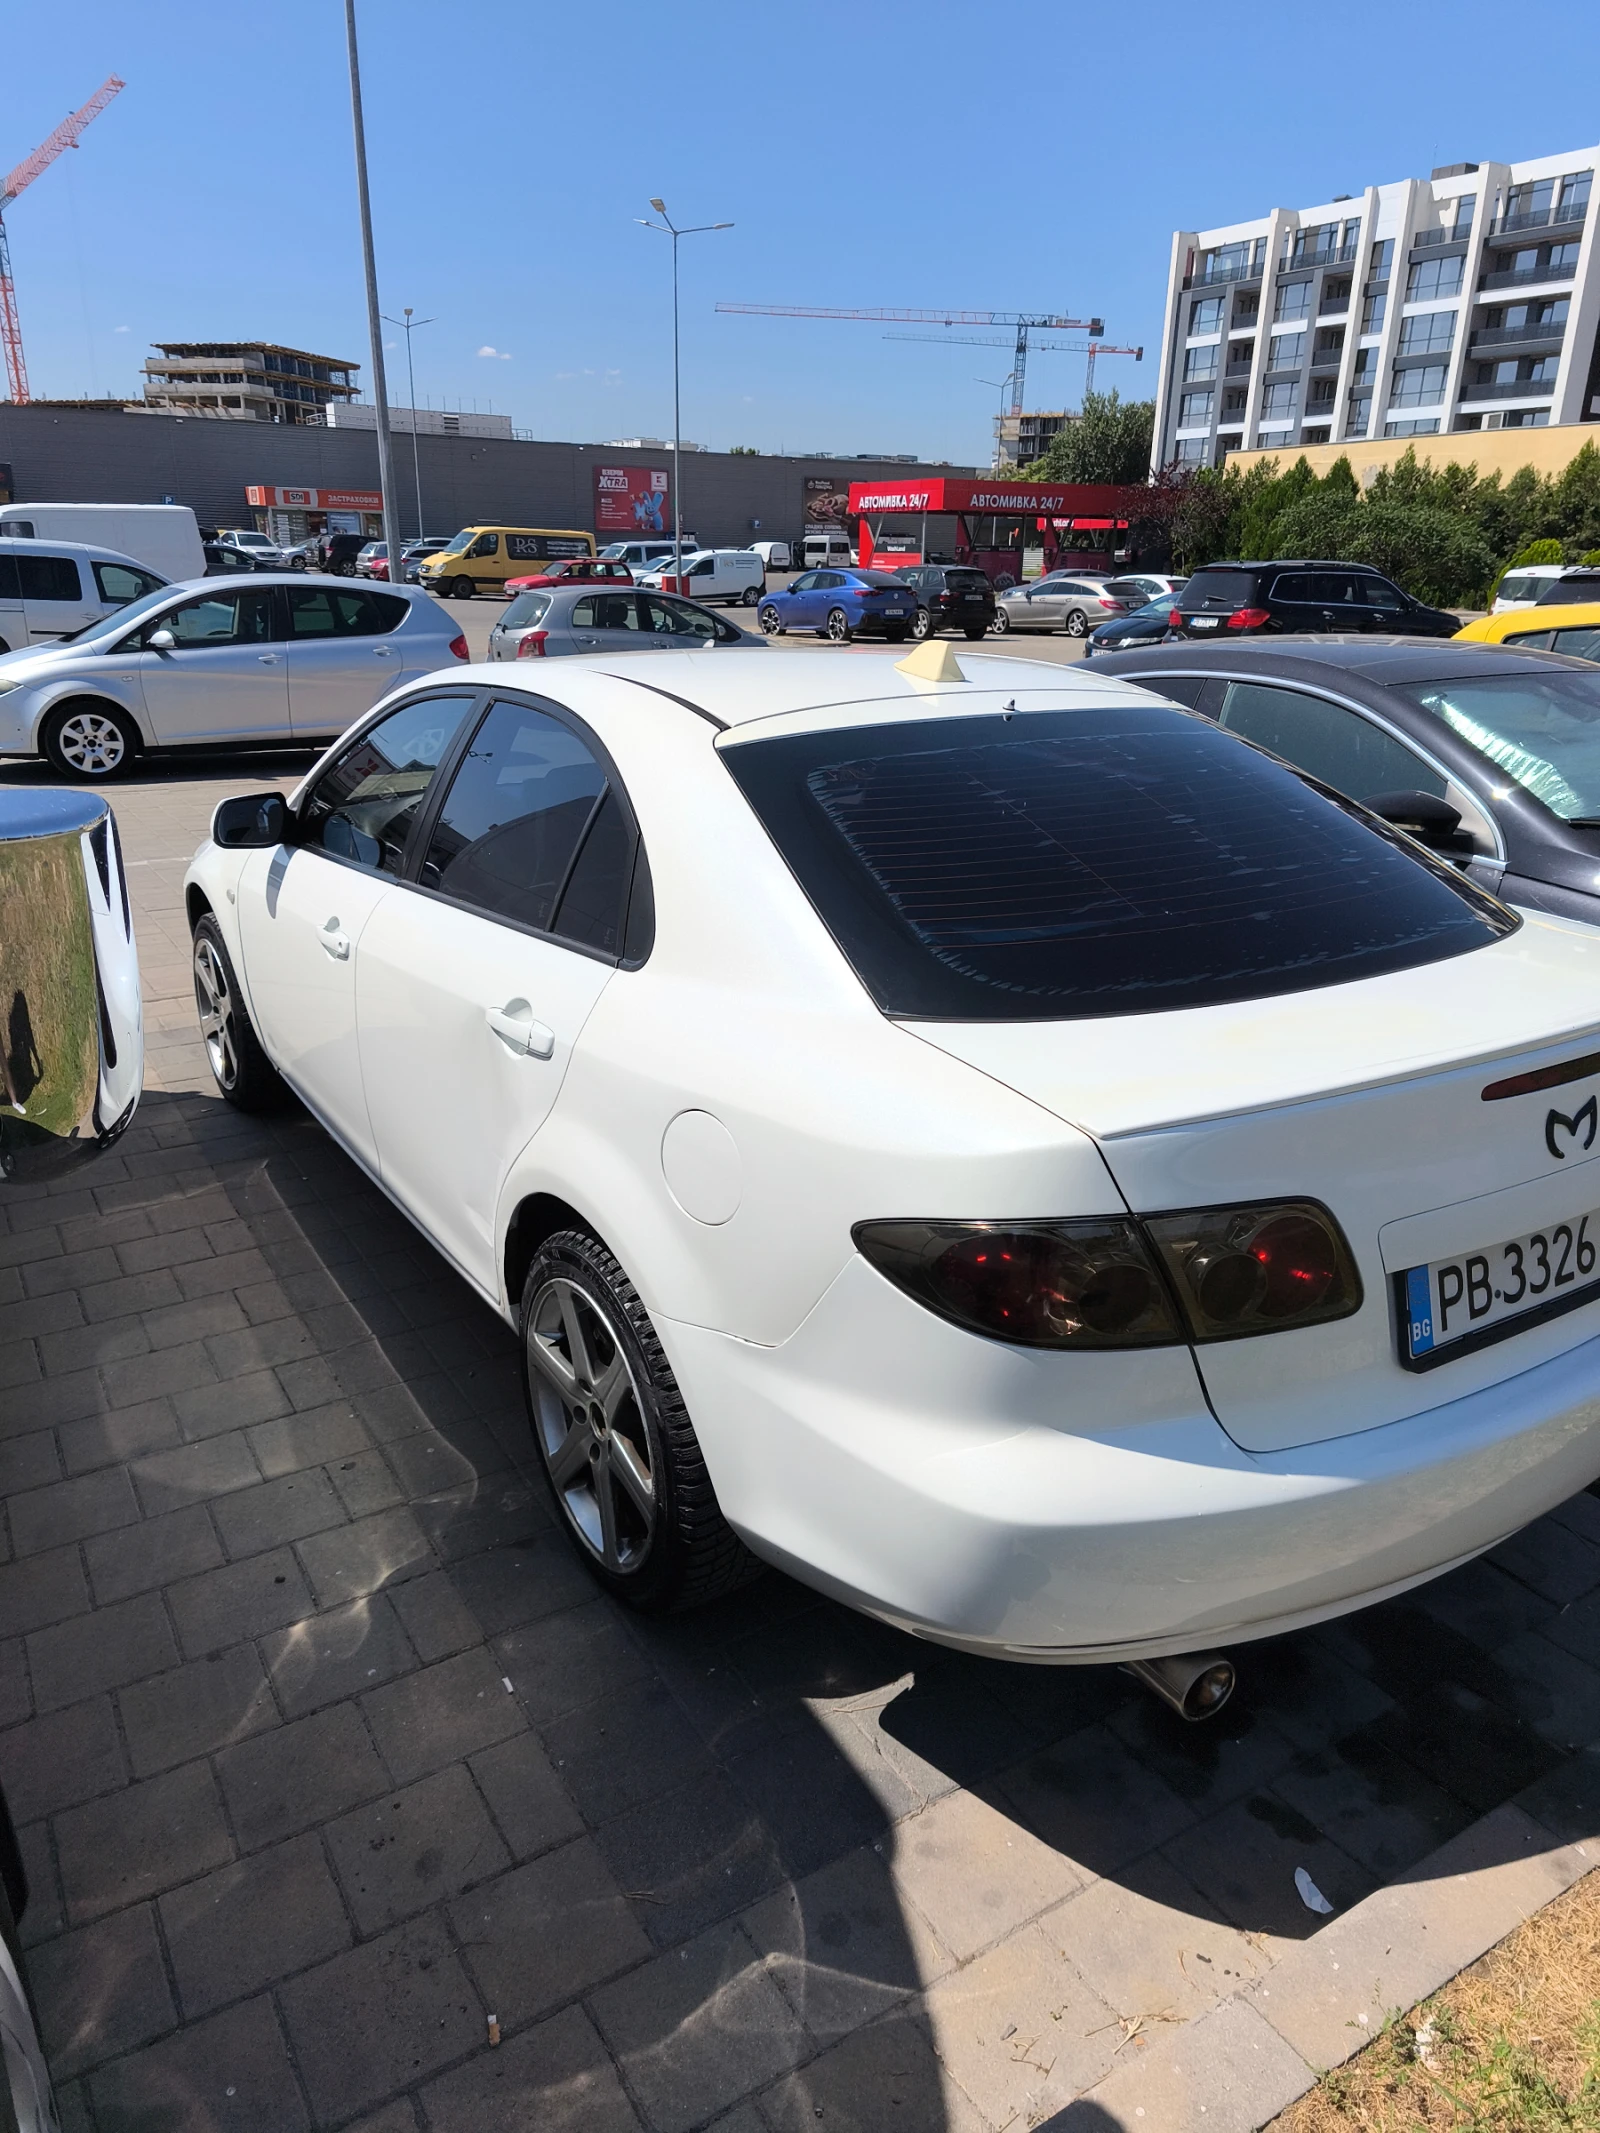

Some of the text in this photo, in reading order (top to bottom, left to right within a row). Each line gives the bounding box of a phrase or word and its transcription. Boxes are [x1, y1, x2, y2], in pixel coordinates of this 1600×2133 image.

[858, 493, 929, 509] АВТОМИВКА 24/7
[970, 494, 1064, 511] АВТОМИВКА 24/7
[1412, 1318, 1431, 1342] BG
